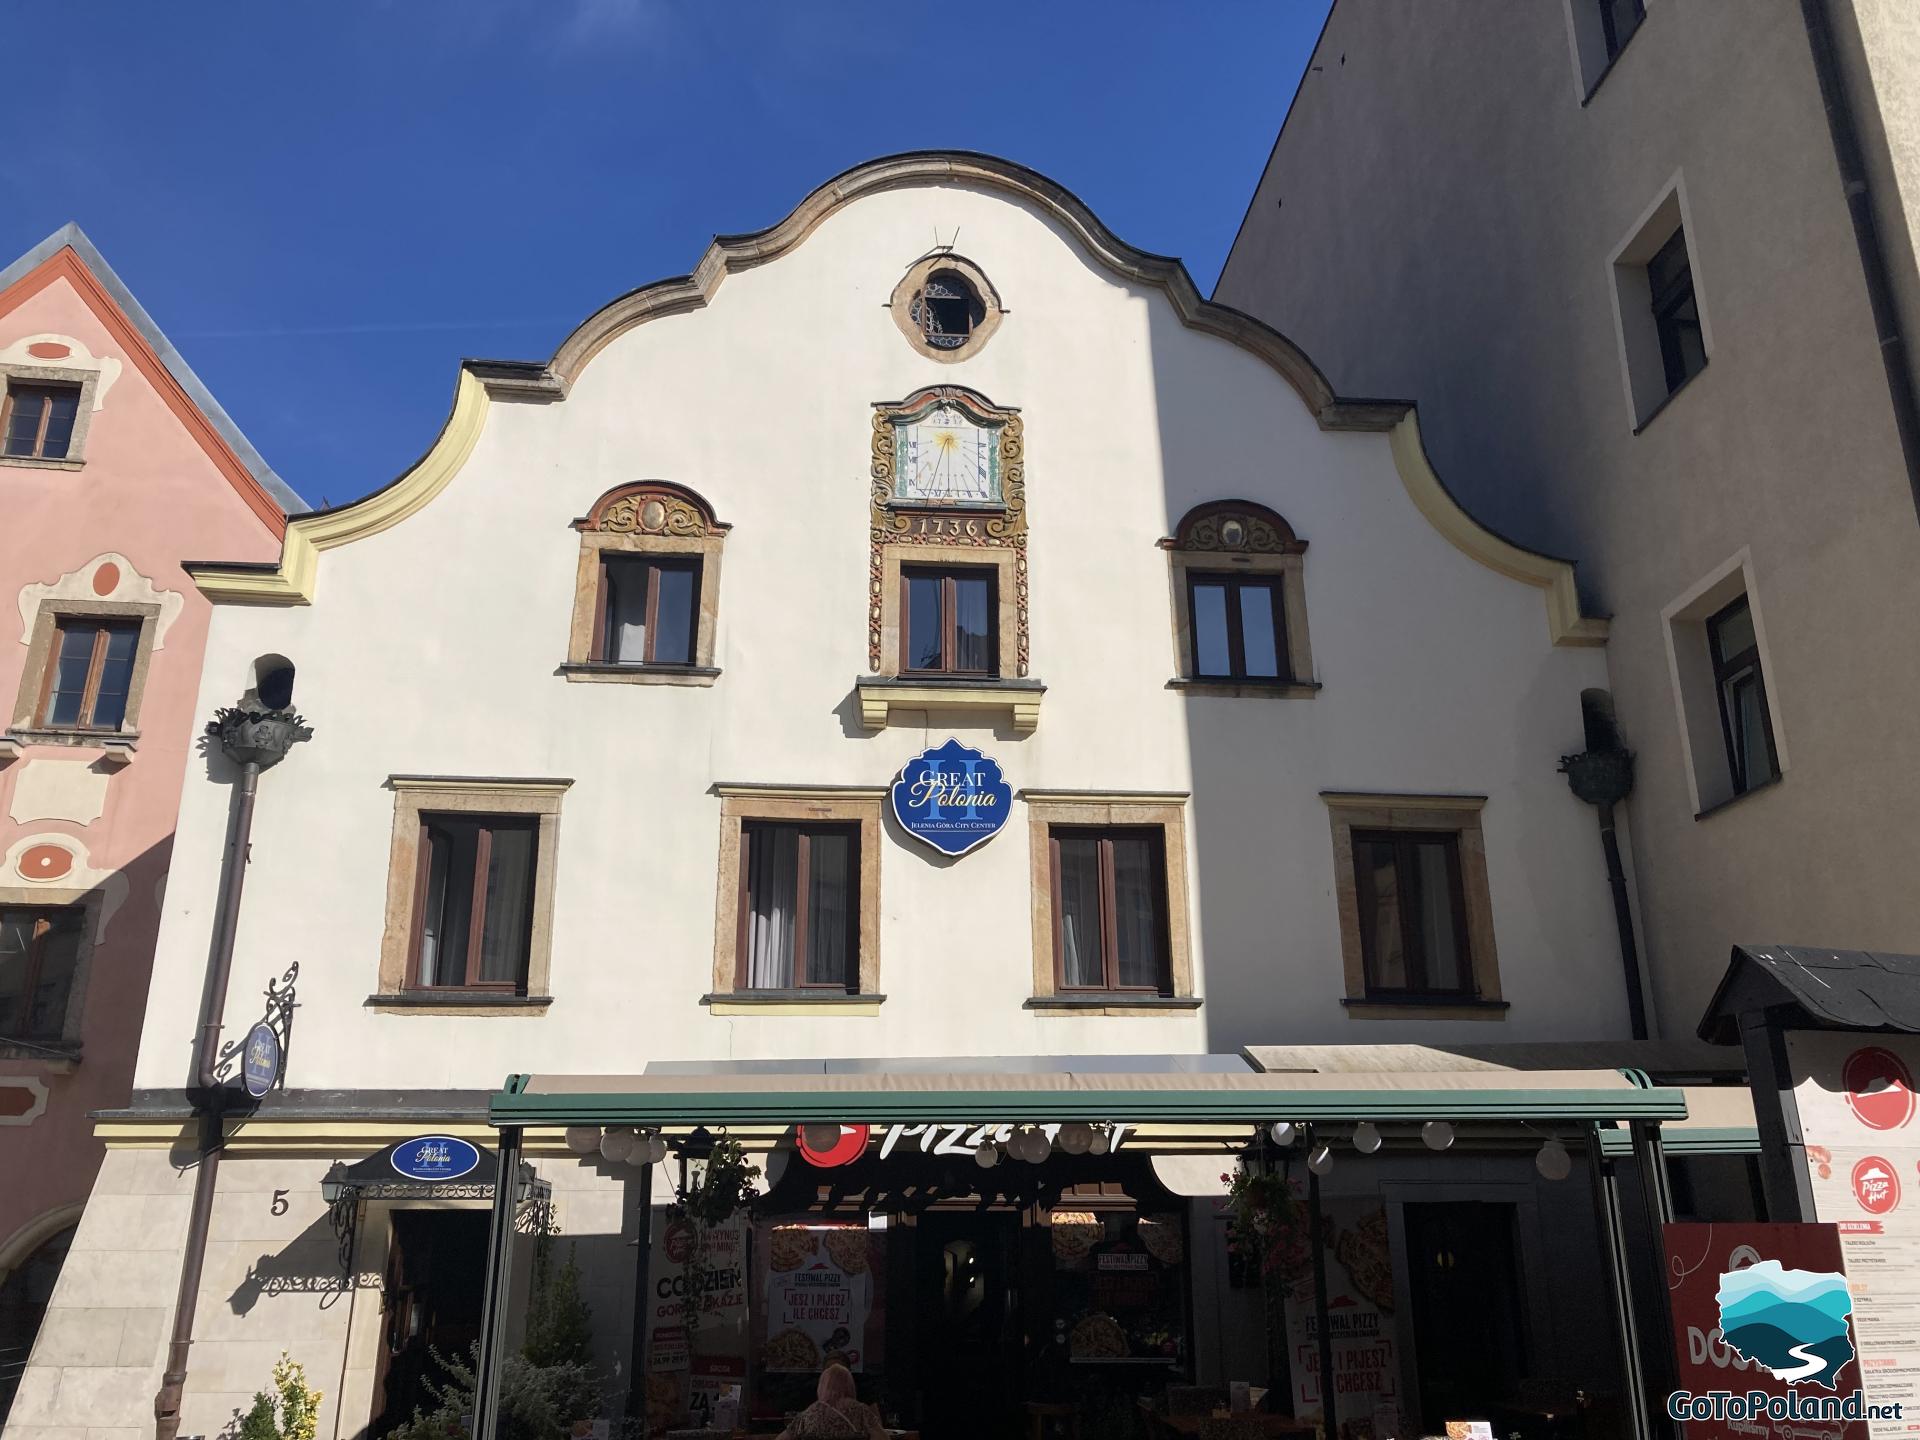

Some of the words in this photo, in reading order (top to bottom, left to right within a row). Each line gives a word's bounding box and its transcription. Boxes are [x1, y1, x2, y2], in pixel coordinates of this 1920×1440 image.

[920, 519, 978, 537] 1736
[919, 770, 986, 787] GREAT
[908, 780, 997, 807] Polonia
[415, 1150, 451, 1163] Polonia
[1862, 1179, 1889, 1196] Pizza
[270, 1189, 290, 1217] 5
[1867, 1189, 1889, 1205] Hut
[794, 1273, 822, 1282] FESTIWAL
[789, 1294, 809, 1306] JESZ
[817, 1294, 846, 1306] PIJESZ
[793, 1307, 805, 1320] ILE
[808, 1307, 840, 1320] CHCESZ
[1352, 1312, 1379, 1329] PIZZY
[1346, 1348, 1388, 1371] PIJESZ
[1336, 1371, 1382, 1393] CHCESZ
